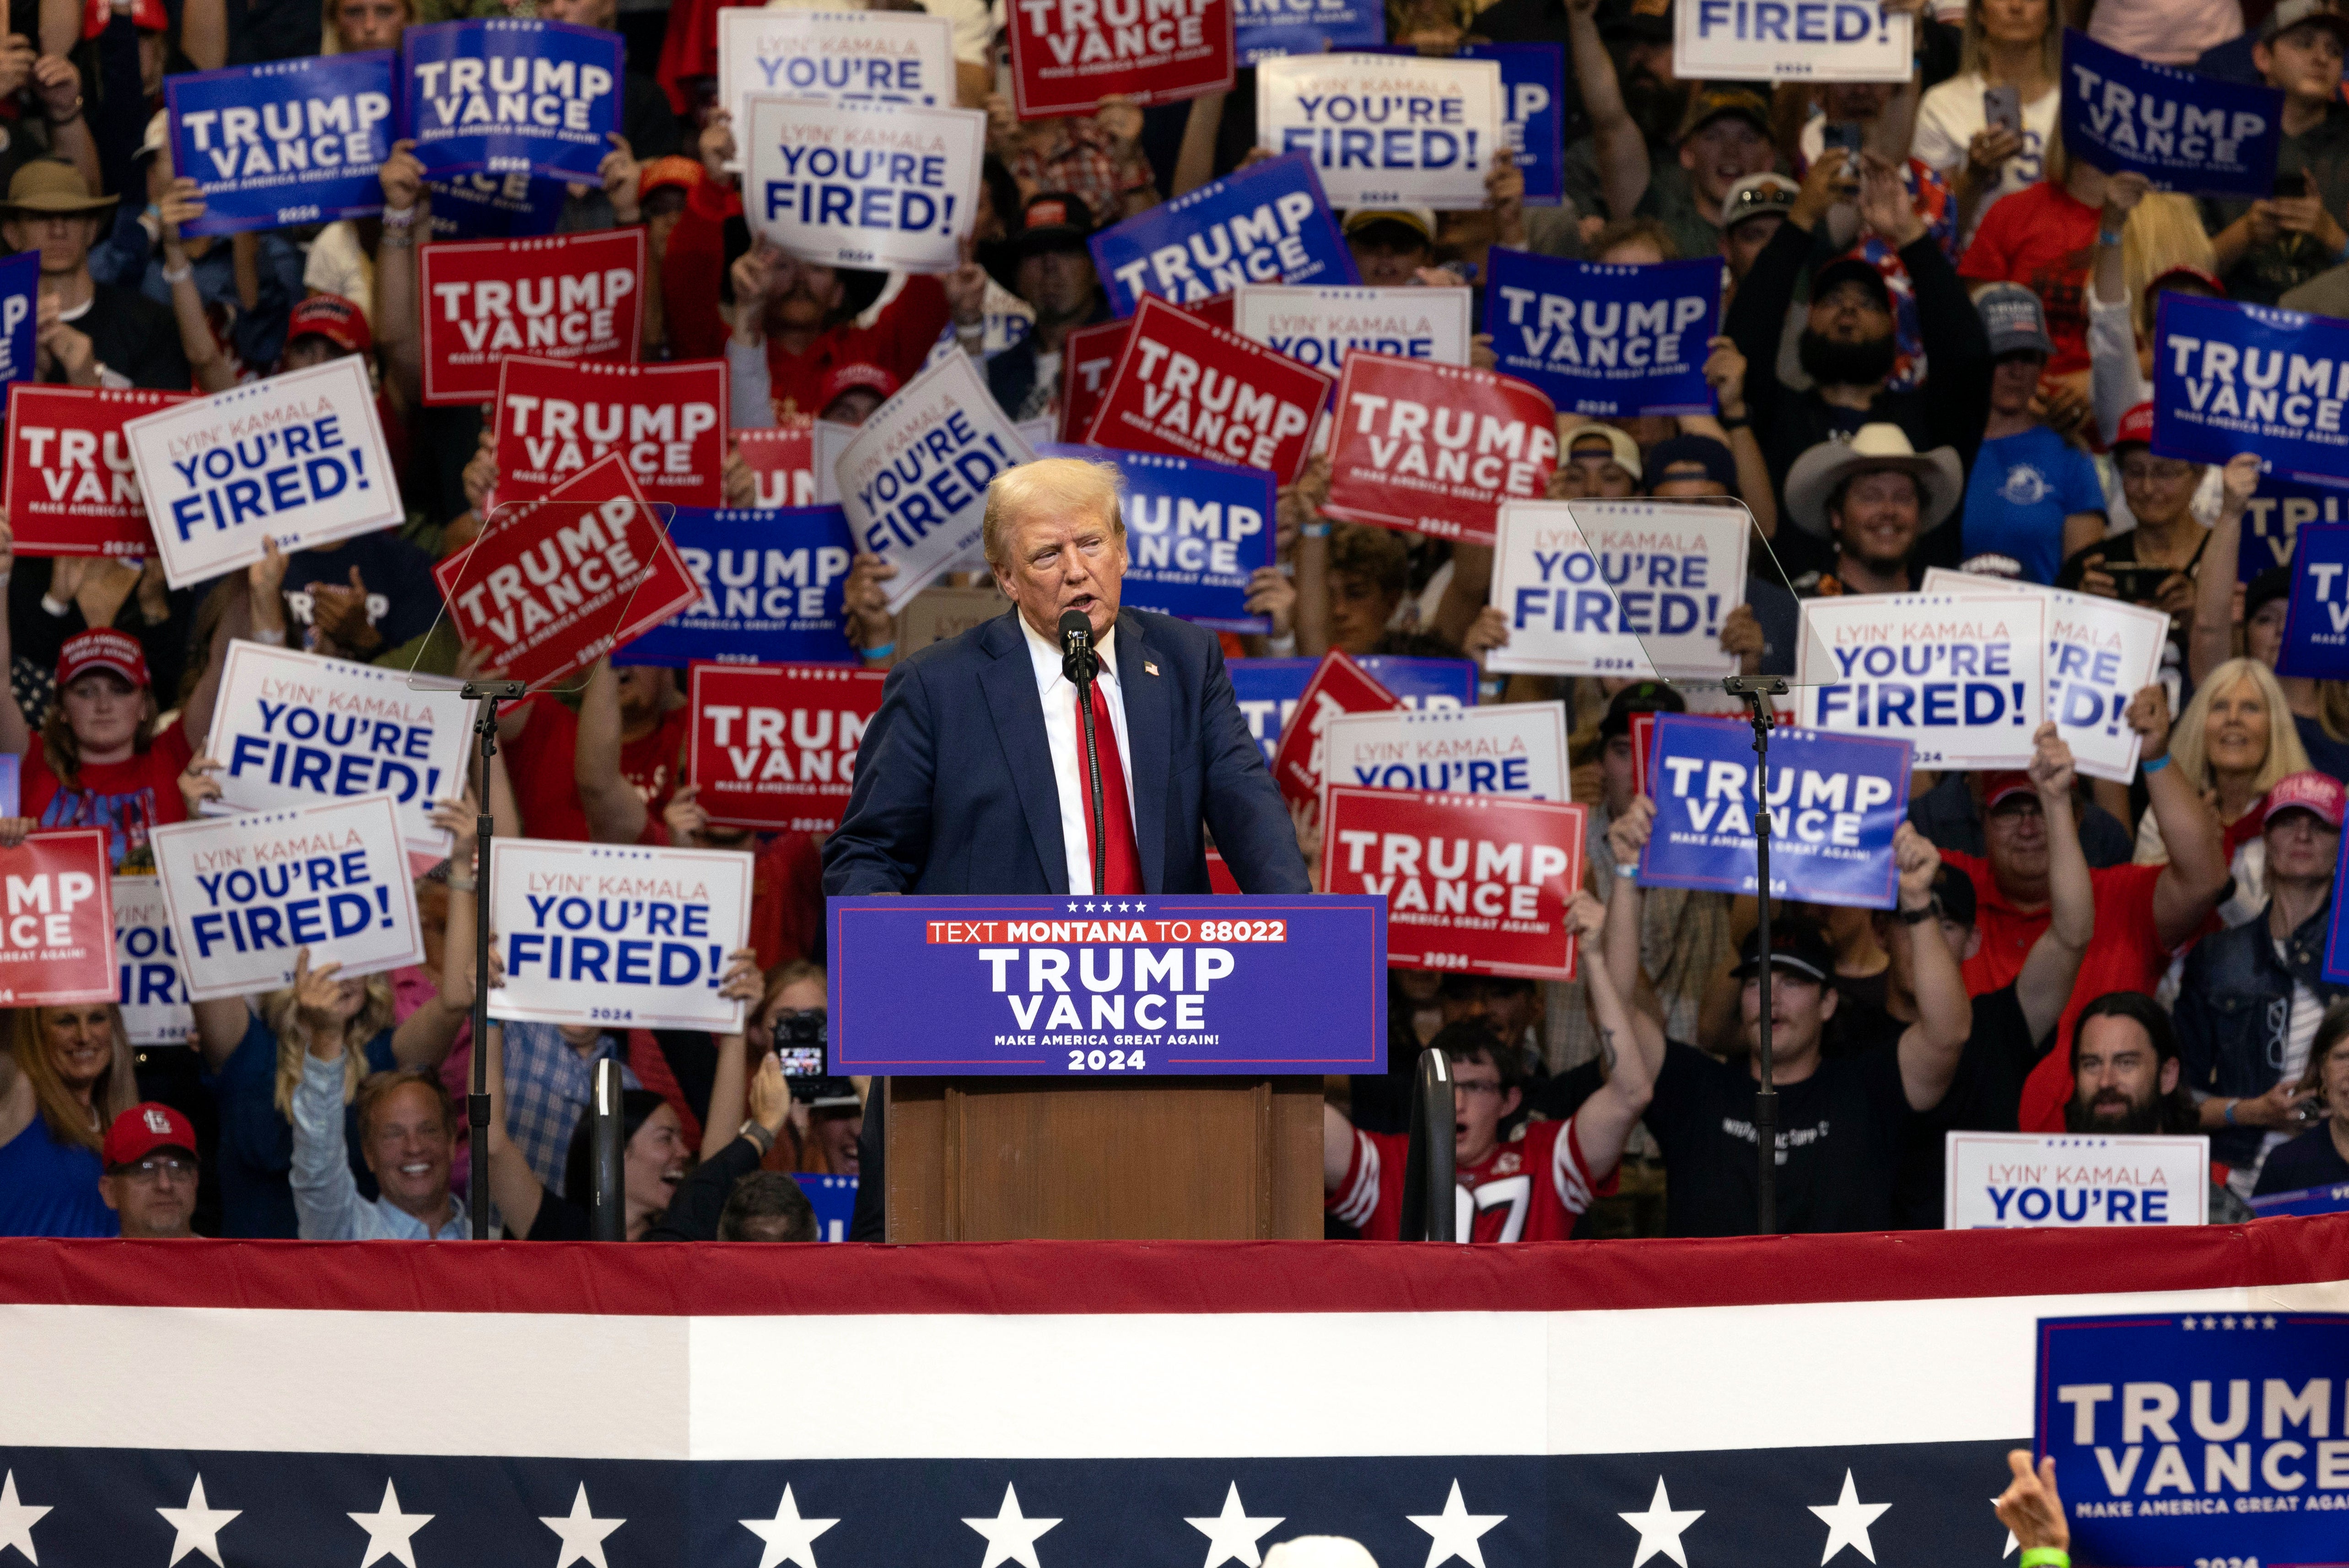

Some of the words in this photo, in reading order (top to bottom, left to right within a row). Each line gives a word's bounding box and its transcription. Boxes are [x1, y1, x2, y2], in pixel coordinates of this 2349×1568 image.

[1046, 16, 1204, 65] VANCE
[1698, 1, 1890, 43] FIRED!
[819, 38, 921, 56] KAMALA
[415, 56, 614, 101] TRUMP
[755, 56, 922, 90] YOU'RE
[1361, 77, 1462, 95] KAMALA
[184, 93, 390, 151] TRUMP
[435, 93, 591, 130] VANCE
[1297, 95, 1465, 124] YOU'RE
[2071, 63, 2266, 138] TRUMP
[843, 128, 946, 152] KAMALA
[1282, 128, 1479, 170] FIRED!
[2088, 102, 2242, 163] VANCE
[209, 133, 372, 179] VANCE
[780, 145, 946, 187] YOU'RE
[765, 180, 955, 236] FIRED!
[1114, 191, 1315, 301] TRUMP
[433, 267, 635, 322] TRUMP
[1499, 285, 1707, 339] TRUMP
[458, 307, 615, 350] VANCE
[1333, 316, 1433, 334] KAMALA
[1520, 324, 1681, 367] VANCE
[1137, 336, 1309, 440] TRUMP
[2184, 376, 2344, 433] VANCE
[229, 395, 334, 436] KAMALA
[506, 393, 717, 443] TRUMP
[1143, 382, 1279, 470] VANCE
[1351, 391, 1557, 463] TRUMP
[172, 414, 345, 489] YOU'RE
[858, 408, 978, 517] YOU'RE
[1368, 435, 1536, 496] VANCE
[170, 447, 370, 544] FIRED!
[1131, 493, 1262, 543] UMP
[458, 495, 636, 627] TRUMP
[1534, 529, 1595, 548] LYIN'
[1602, 531, 1708, 552] KAMALA
[679, 546, 850, 587] RUMP
[1533, 550, 1709, 589] YOU'RE
[486, 539, 641, 644] VANCE
[686, 586, 827, 619] ANCE
[1514, 587, 1721, 638] FIRED!
[1835, 625, 1895, 645] LYIN'
[1903, 621, 2011, 643] KAMALA
[1594, 657, 1634, 670] 2024
[1834, 642, 2012, 678] YOU'RE
[261, 676, 322, 705] LYIN'
[327, 689, 435, 725] KAMALA
[1817, 681, 2025, 727] FIRED!
[258, 697, 434, 761] YOU'RE
[703, 704, 876, 751] TRUM
[1354, 742, 1410, 765] LYIN'
[1417, 734, 1527, 761] KAMALA
[229, 734, 442, 811] FIRED!
[727, 745, 857, 782] VANC
[1354, 757, 1530, 795] YOU'RE
[1664, 755, 1893, 814] TRUMP
[1685, 797, 1863, 847] VANCE
[193, 848, 247, 871] LYIN'
[253, 827, 364, 863] KAMALA
[1338, 829, 1568, 886] TRUMP
[196, 849, 371, 907] YOU'RE
[528, 872, 590, 893] LYIN'
[598, 874, 710, 901] KAMALA
[1362, 873, 1541, 920] VANCE
[191, 885, 394, 959] FIRED!
[526, 894, 711, 938] YOU'RE
[930, 922, 998, 943] TEXT
[1007, 921, 1145, 942] MONTANA
[1156, 921, 1192, 941] TO
[1200, 921, 1285, 942] 88022
[1453, 916, 1500, 931] GREAT
[1501, 920, 1551, 934] AGAIN!
[507, 932, 723, 989] FIRED!
[978, 948, 1235, 992] TRUMP
[591, 1008, 633, 1021] 2024
[1007, 994, 1206, 1031] VANCE
[995, 1035, 1036, 1046] MAKE
[1041, 1035, 1109, 1046] AMERICA
[1113, 1035, 1163, 1046] GREAT
[1167, 1035, 1220, 1045] AGAIN!
[1068, 1050, 1146, 1071] 2024
[1988, 1163, 2047, 1185] LYIN'
[2056, 1165, 2167, 1187] KAMALA
[1985, 1186, 2169, 1223] YOU'RE
[2058, 1377, 2349, 1446] TRUM
[2094, 1440, 2349, 1497] VANCE
[2076, 1500, 2133, 1518] MAKE
[2138, 1498, 2230, 1517] AMERICA
[2234, 1495, 2300, 1513] GREAT
